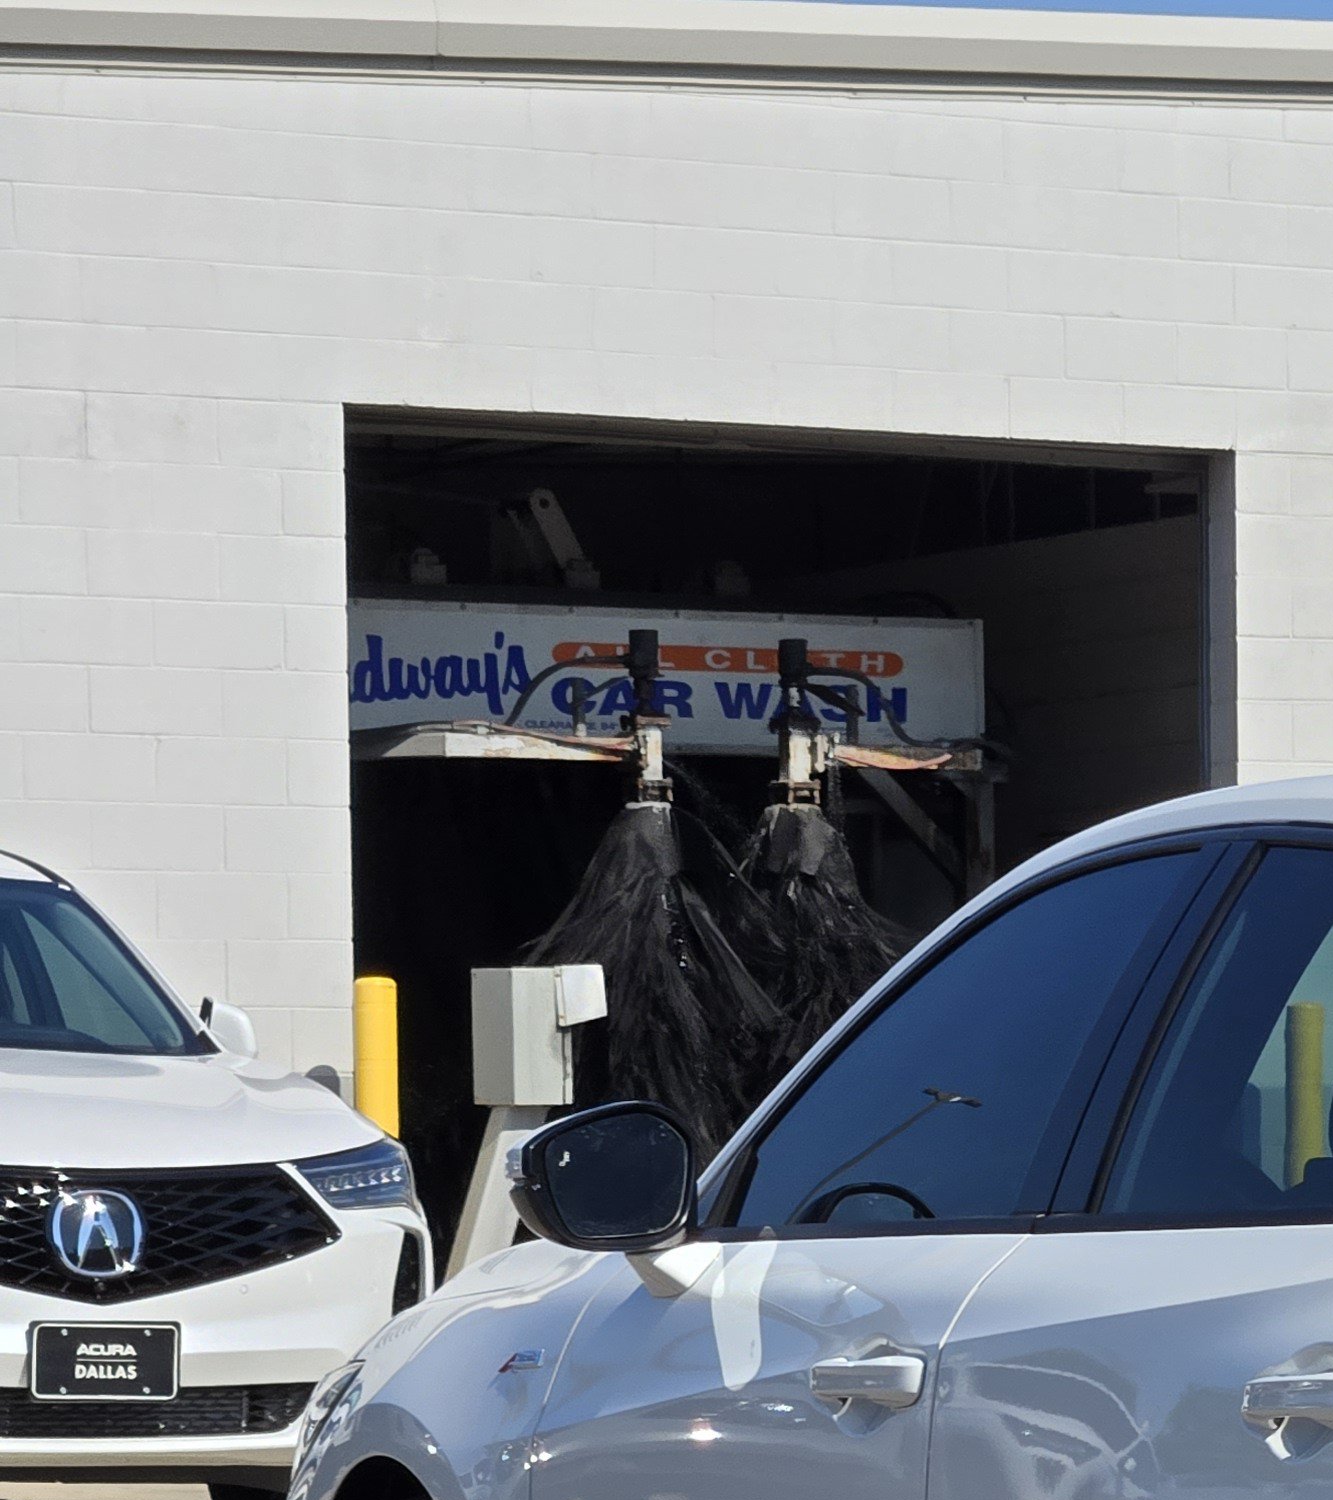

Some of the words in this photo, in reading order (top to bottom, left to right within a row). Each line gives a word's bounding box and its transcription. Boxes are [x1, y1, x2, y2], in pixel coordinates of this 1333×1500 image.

[704, 649, 885, 674] CLTH
[551, 677, 694, 718] CAR
[76, 1343, 138, 1356] ACURA
[74, 1364, 138, 1380] DALLAS
